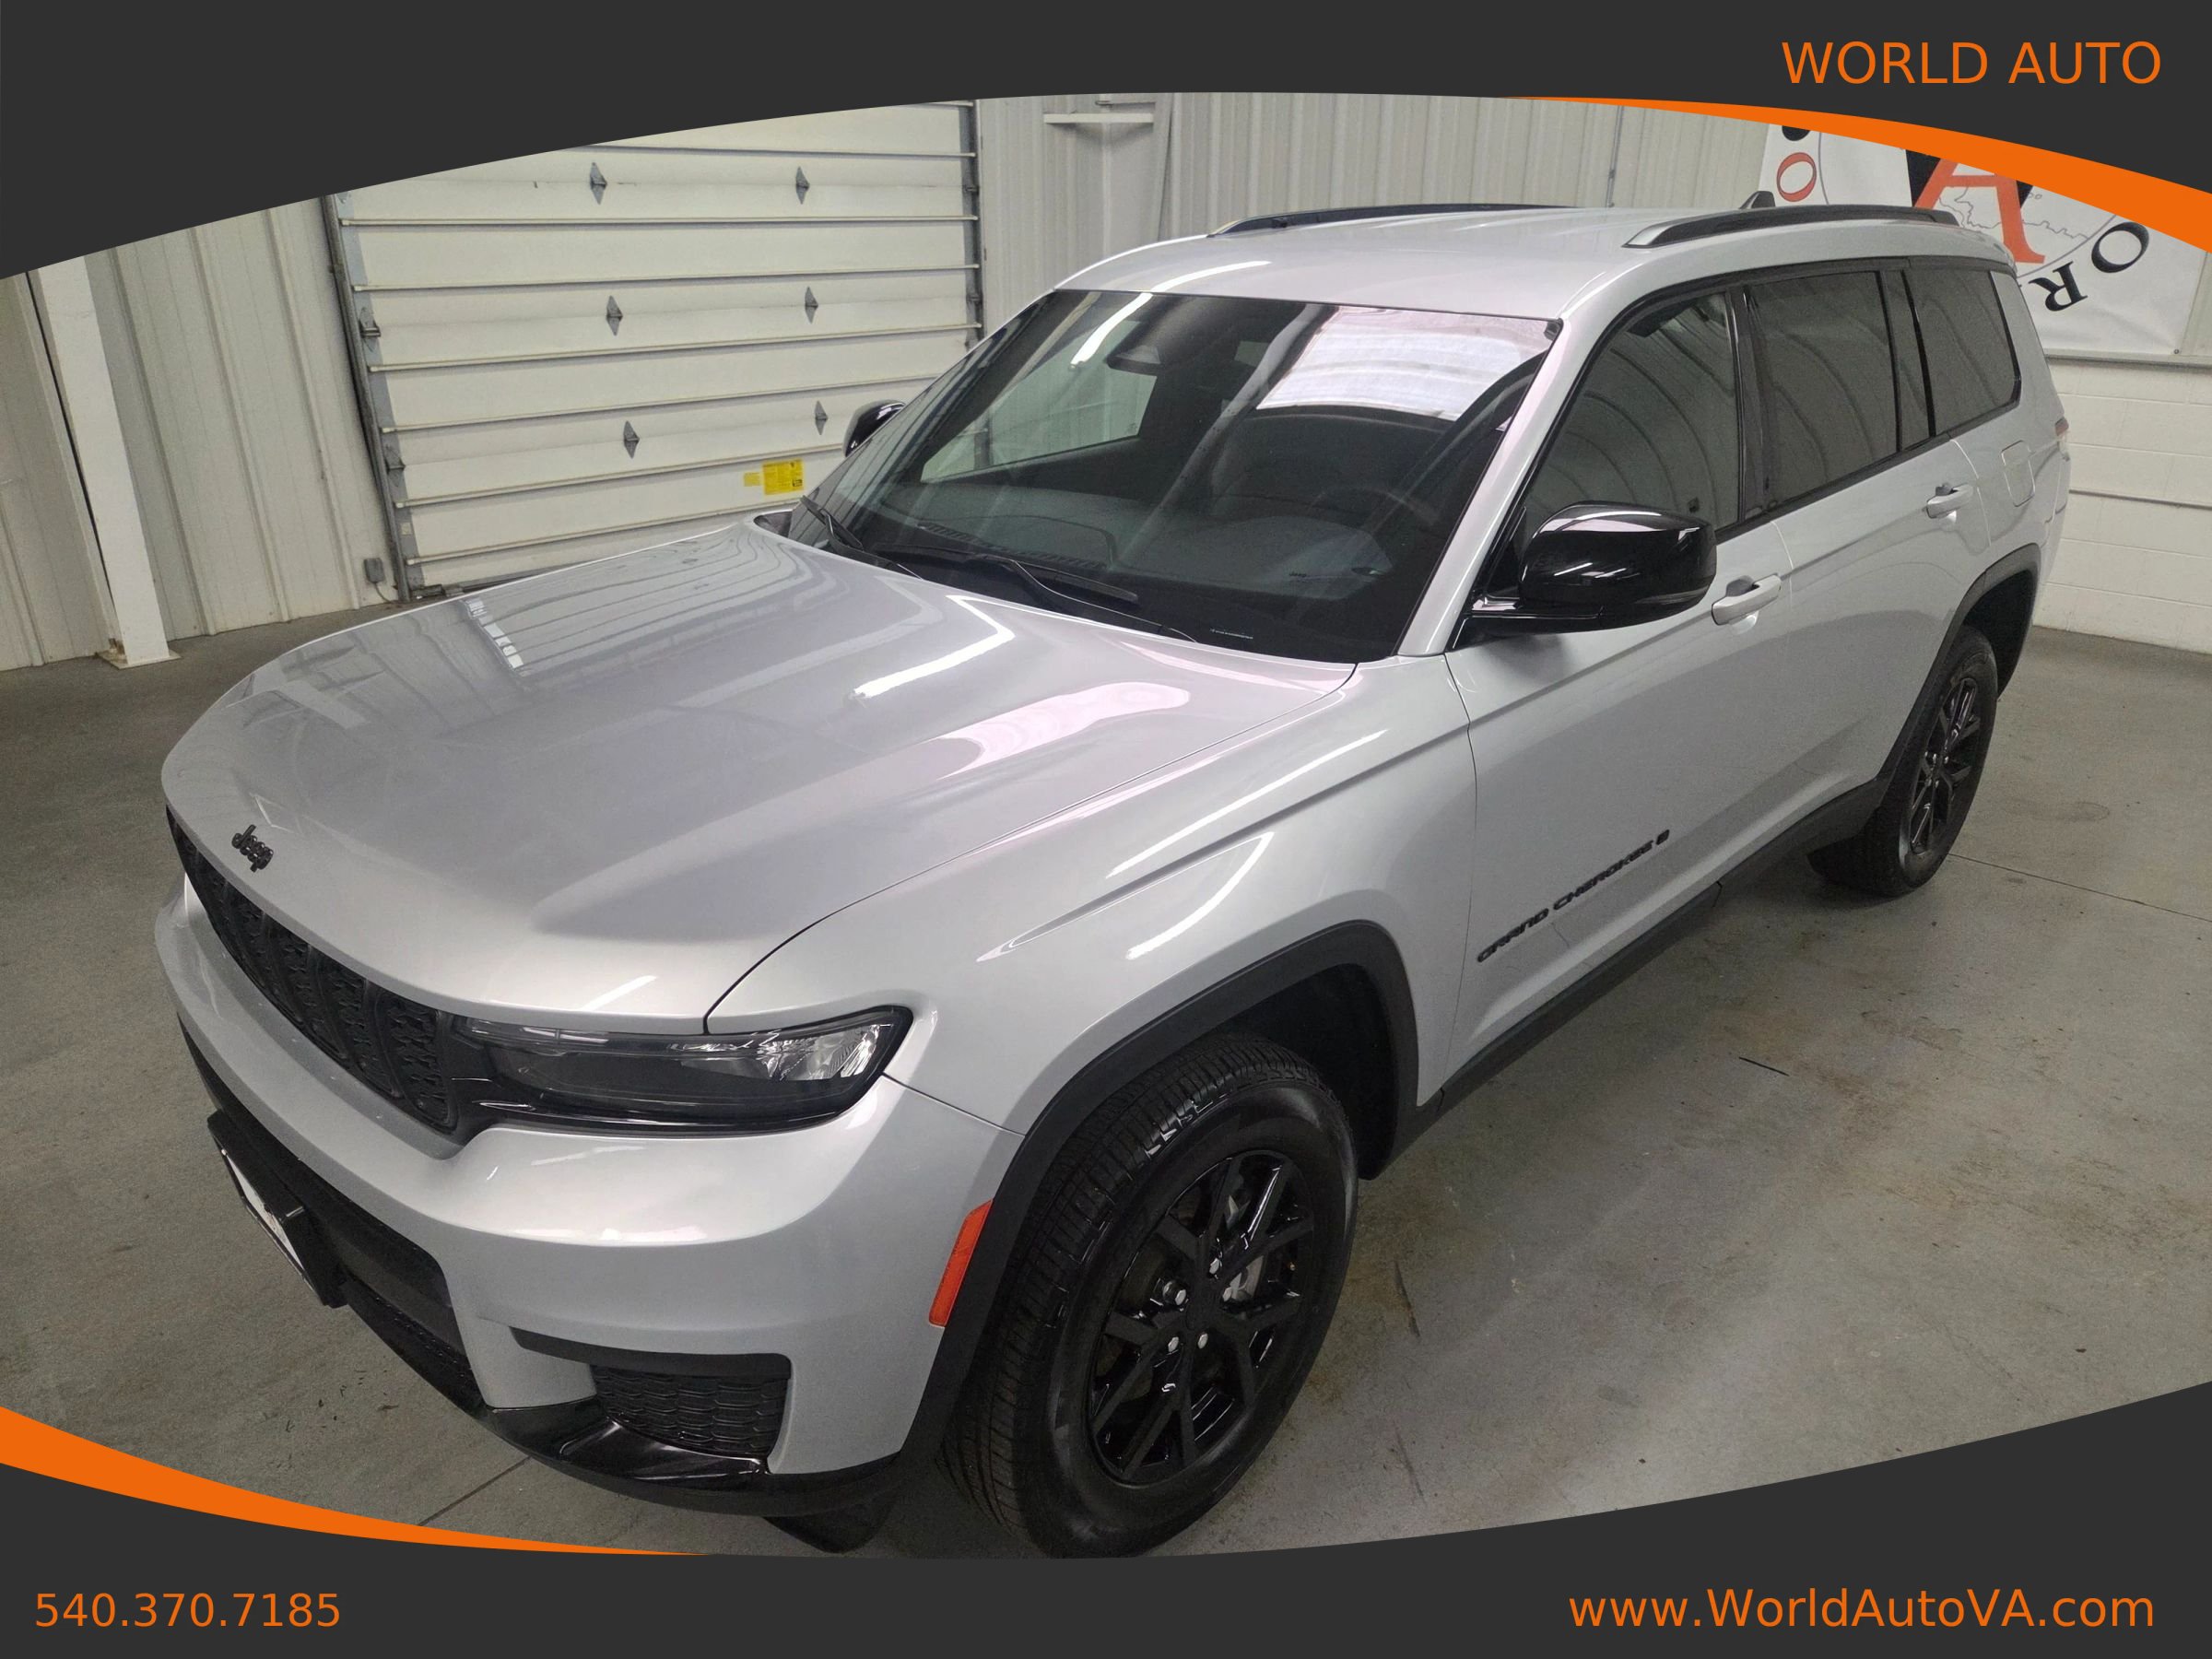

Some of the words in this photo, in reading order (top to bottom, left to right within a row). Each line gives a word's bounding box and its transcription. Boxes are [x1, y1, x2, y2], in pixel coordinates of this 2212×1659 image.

[231, 824, 275, 873] Jeep
[1477, 908, 1549, 963] GRAND
[1553, 840, 1654, 911] CHEROKEE
